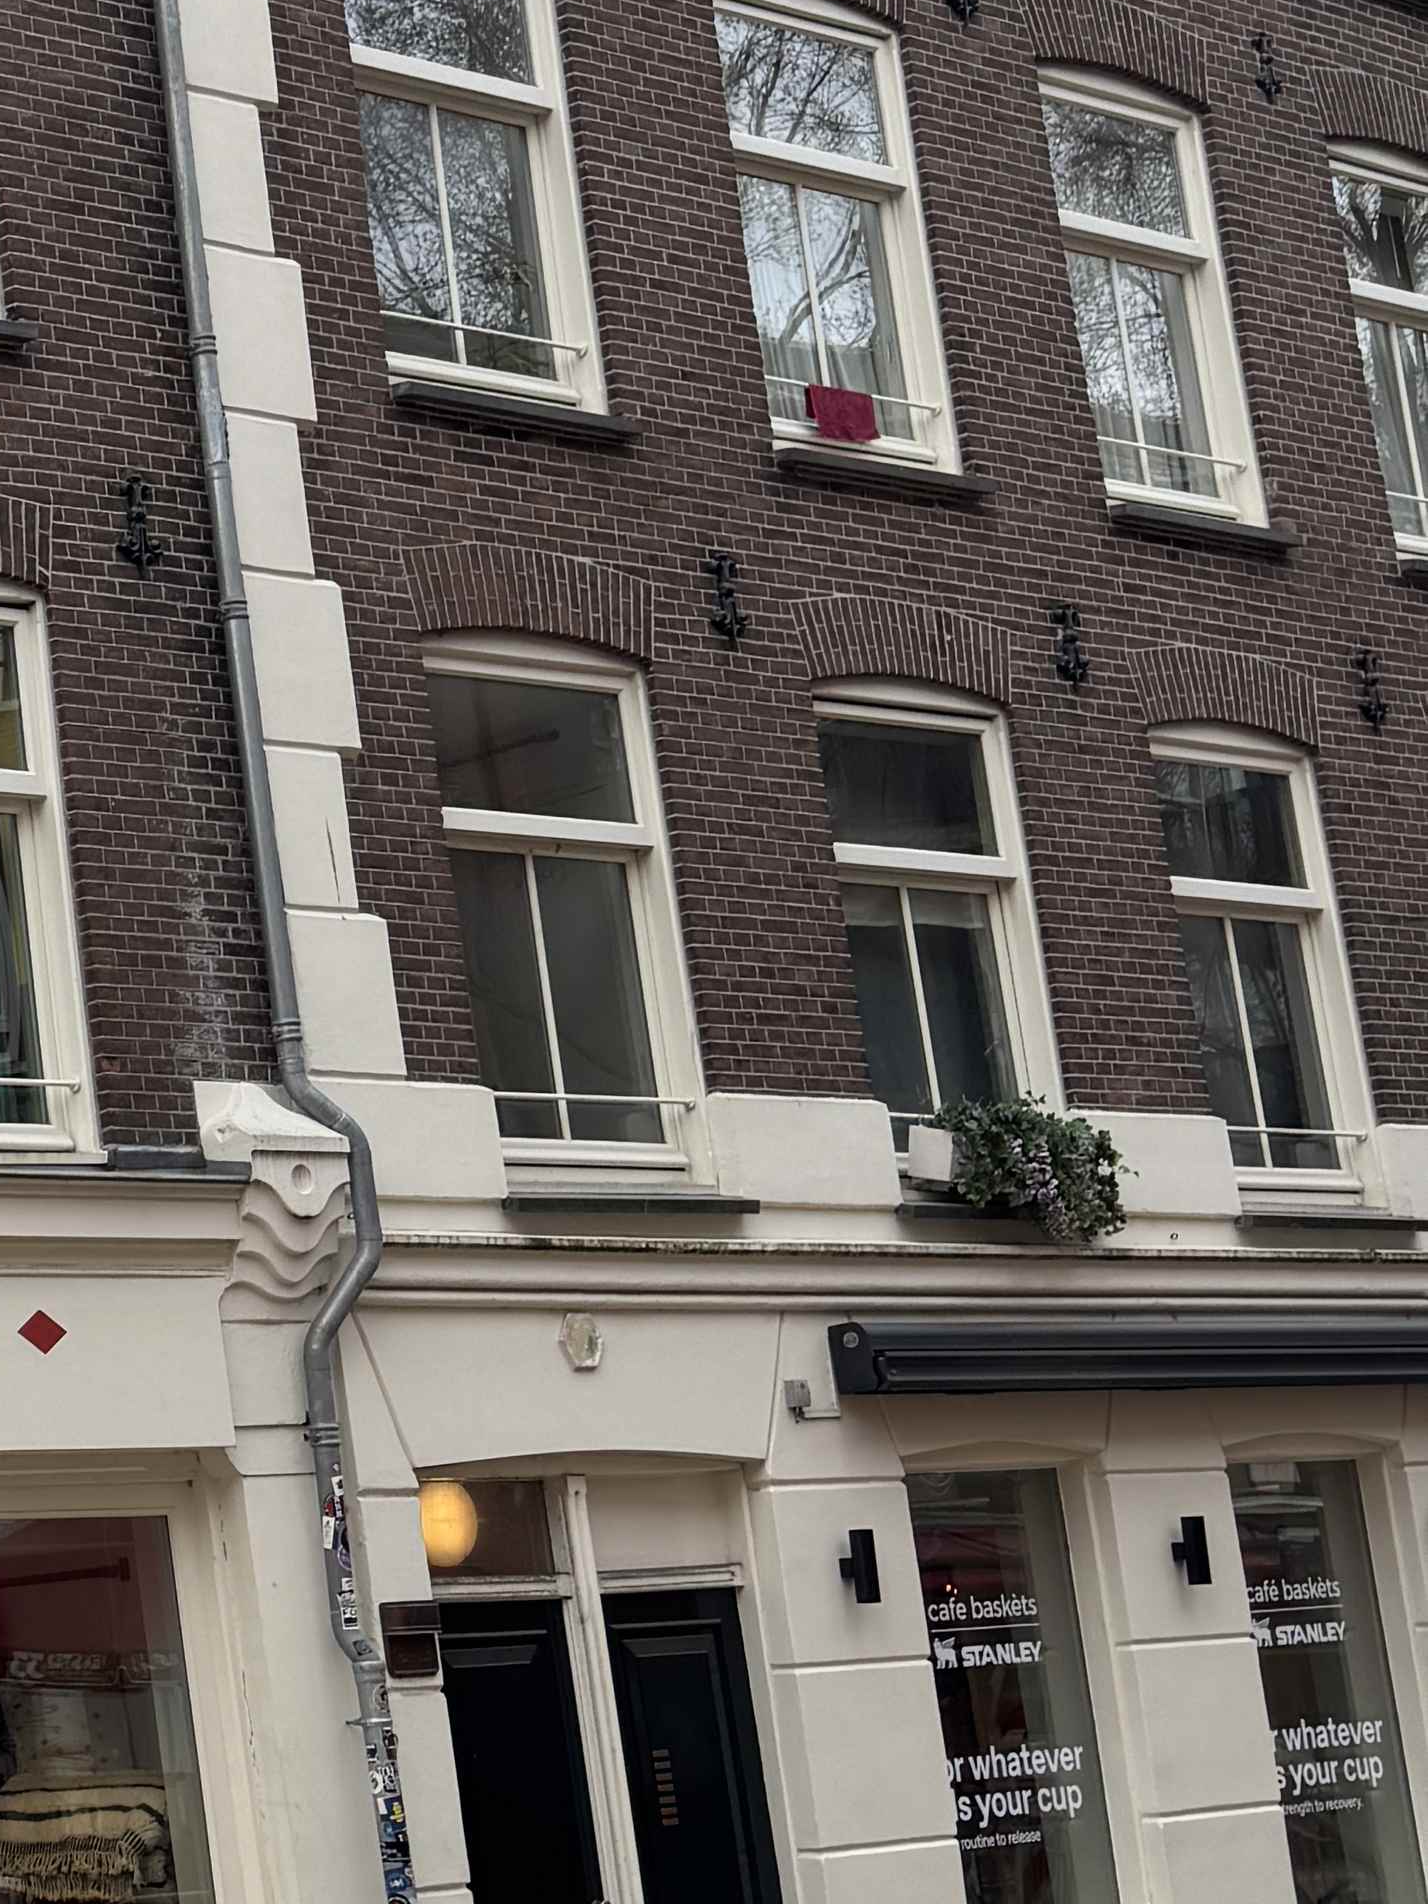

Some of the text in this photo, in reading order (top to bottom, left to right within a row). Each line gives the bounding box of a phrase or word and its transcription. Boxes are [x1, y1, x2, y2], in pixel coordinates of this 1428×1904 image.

[1246, 1576, 1341, 1603] café baskèts
[971, 1594, 1038, 1619] baskèts
[1276, 1621, 1345, 1646] STANLEY
[961, 1640, 1042, 1667] STANLEY
[1283, 1717, 1383, 1752] whatever
[968, 1744, 1084, 1781] whatever
[1290, 1759, 1339, 1795] your
[1344, 1755, 1383, 1788] cup
[975, 1789, 1033, 1829] your
[1038, 1783, 1082, 1818] cup
[1315, 1799, 1325, 1813] to
[961, 1829, 1041, 1851] routine to release
